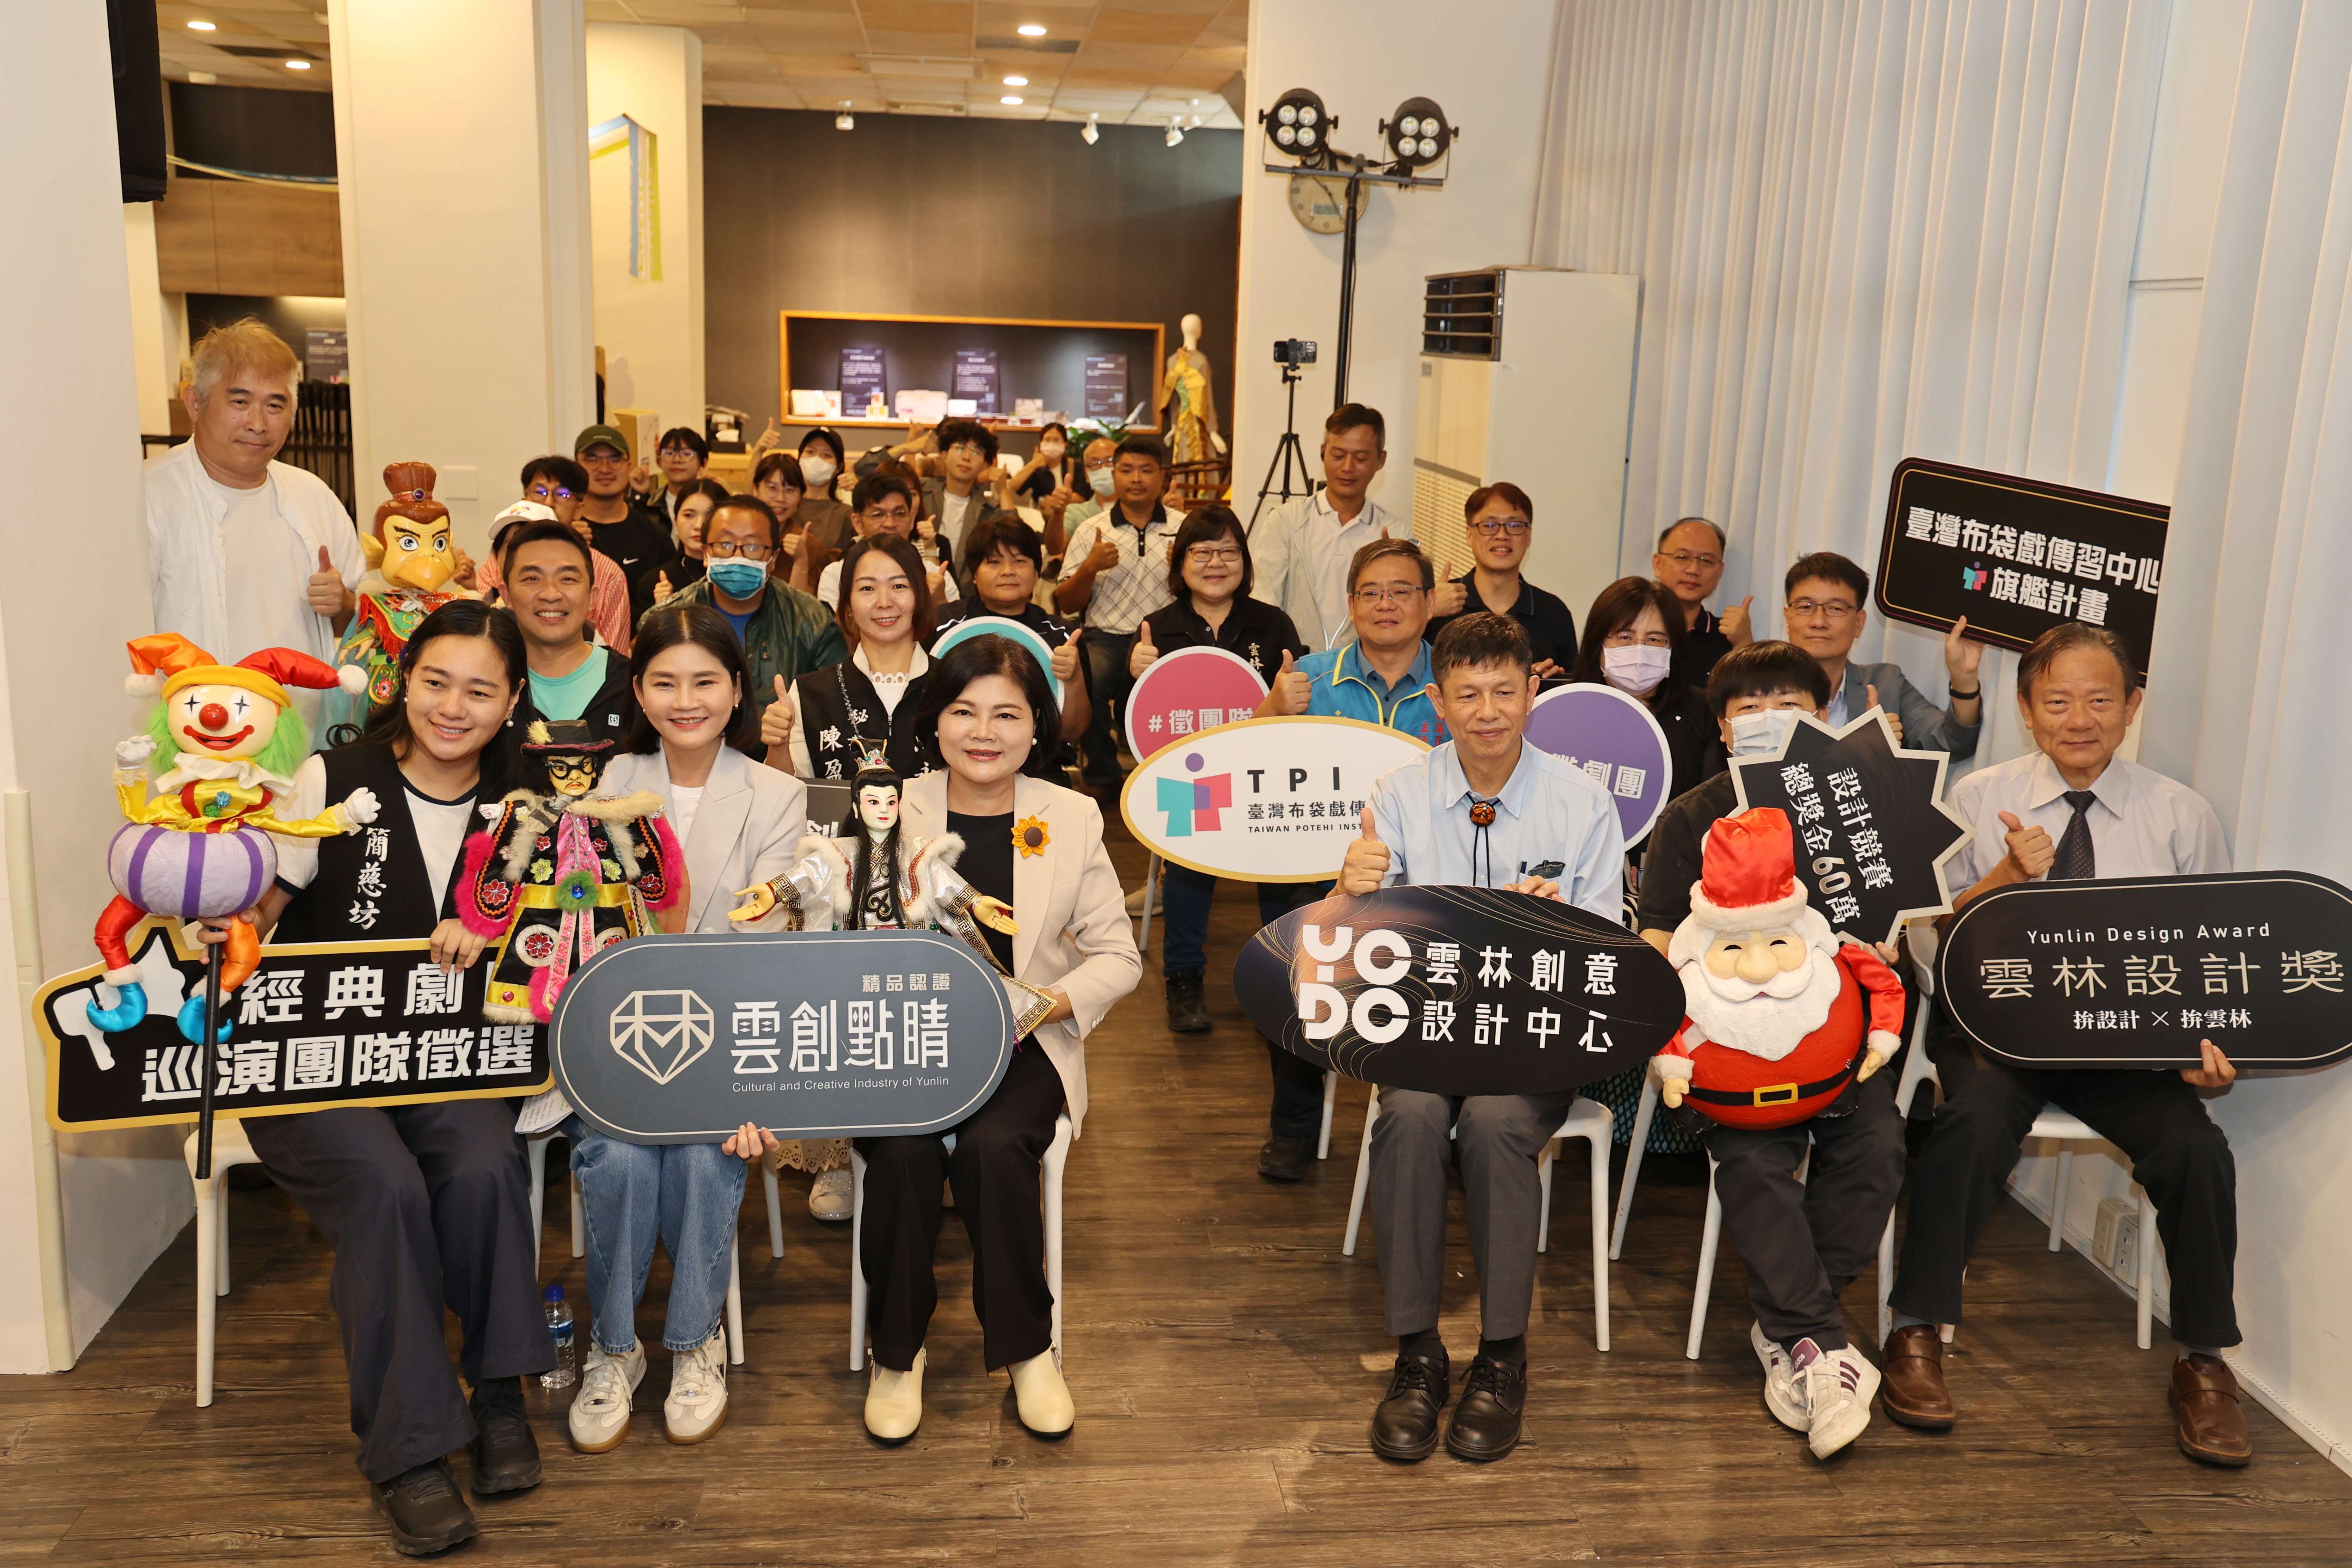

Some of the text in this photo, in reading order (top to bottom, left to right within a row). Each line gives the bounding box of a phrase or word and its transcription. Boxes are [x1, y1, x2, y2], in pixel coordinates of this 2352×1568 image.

[1905, 505, 2161, 595] 臺灣布袋戲傳習中心
[1989, 567, 2110, 626] 旗艦計畫
[1249, 642, 1264, 675] 雲林
[1552, 753, 1647, 799] 劇團
[1248, 800, 1366, 819] 臺灣布袋戲傳
[1826, 767, 1894, 890] 設計競賽
[348, 827, 391, 930] 簡慈坊
[2027, 922, 2271, 944] Yunlin Design Award
[238, 963, 496, 1025] 經典劇
[862, 973, 951, 993] 精品認證
[1425, 942, 1619, 996] 雲林創意
[1980, 950, 2345, 999] 雲林設計獎
[1421, 999, 1614, 1053] 設計中心
[141, 1024, 534, 1102] 巡演團隊徵選
[732, 1076, 949, 1093] Cultural and Creative Industry of Yunlin
